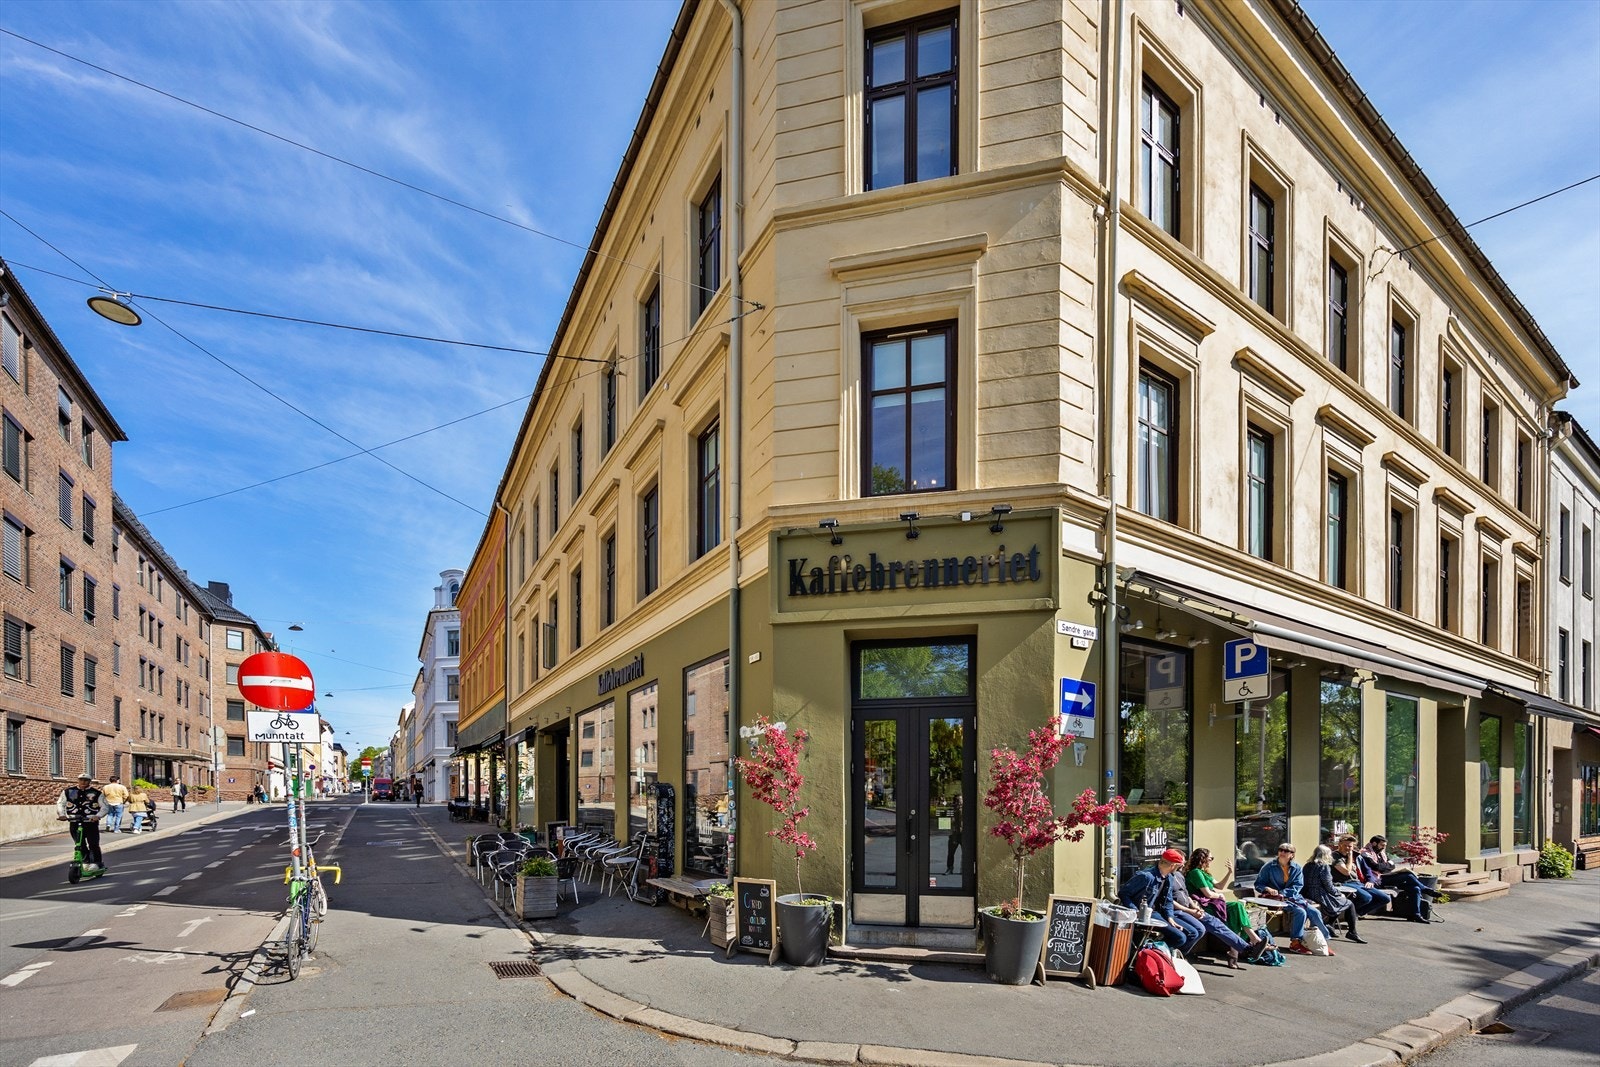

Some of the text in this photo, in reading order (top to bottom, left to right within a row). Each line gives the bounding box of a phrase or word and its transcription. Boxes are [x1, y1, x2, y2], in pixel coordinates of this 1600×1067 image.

[788, 544, 1041, 596] Kaffebrenneriet
[1083, 629, 1095, 637] gate
[1235, 643, 1257, 674] P
[1144, 827, 1168, 846] Kaffe
